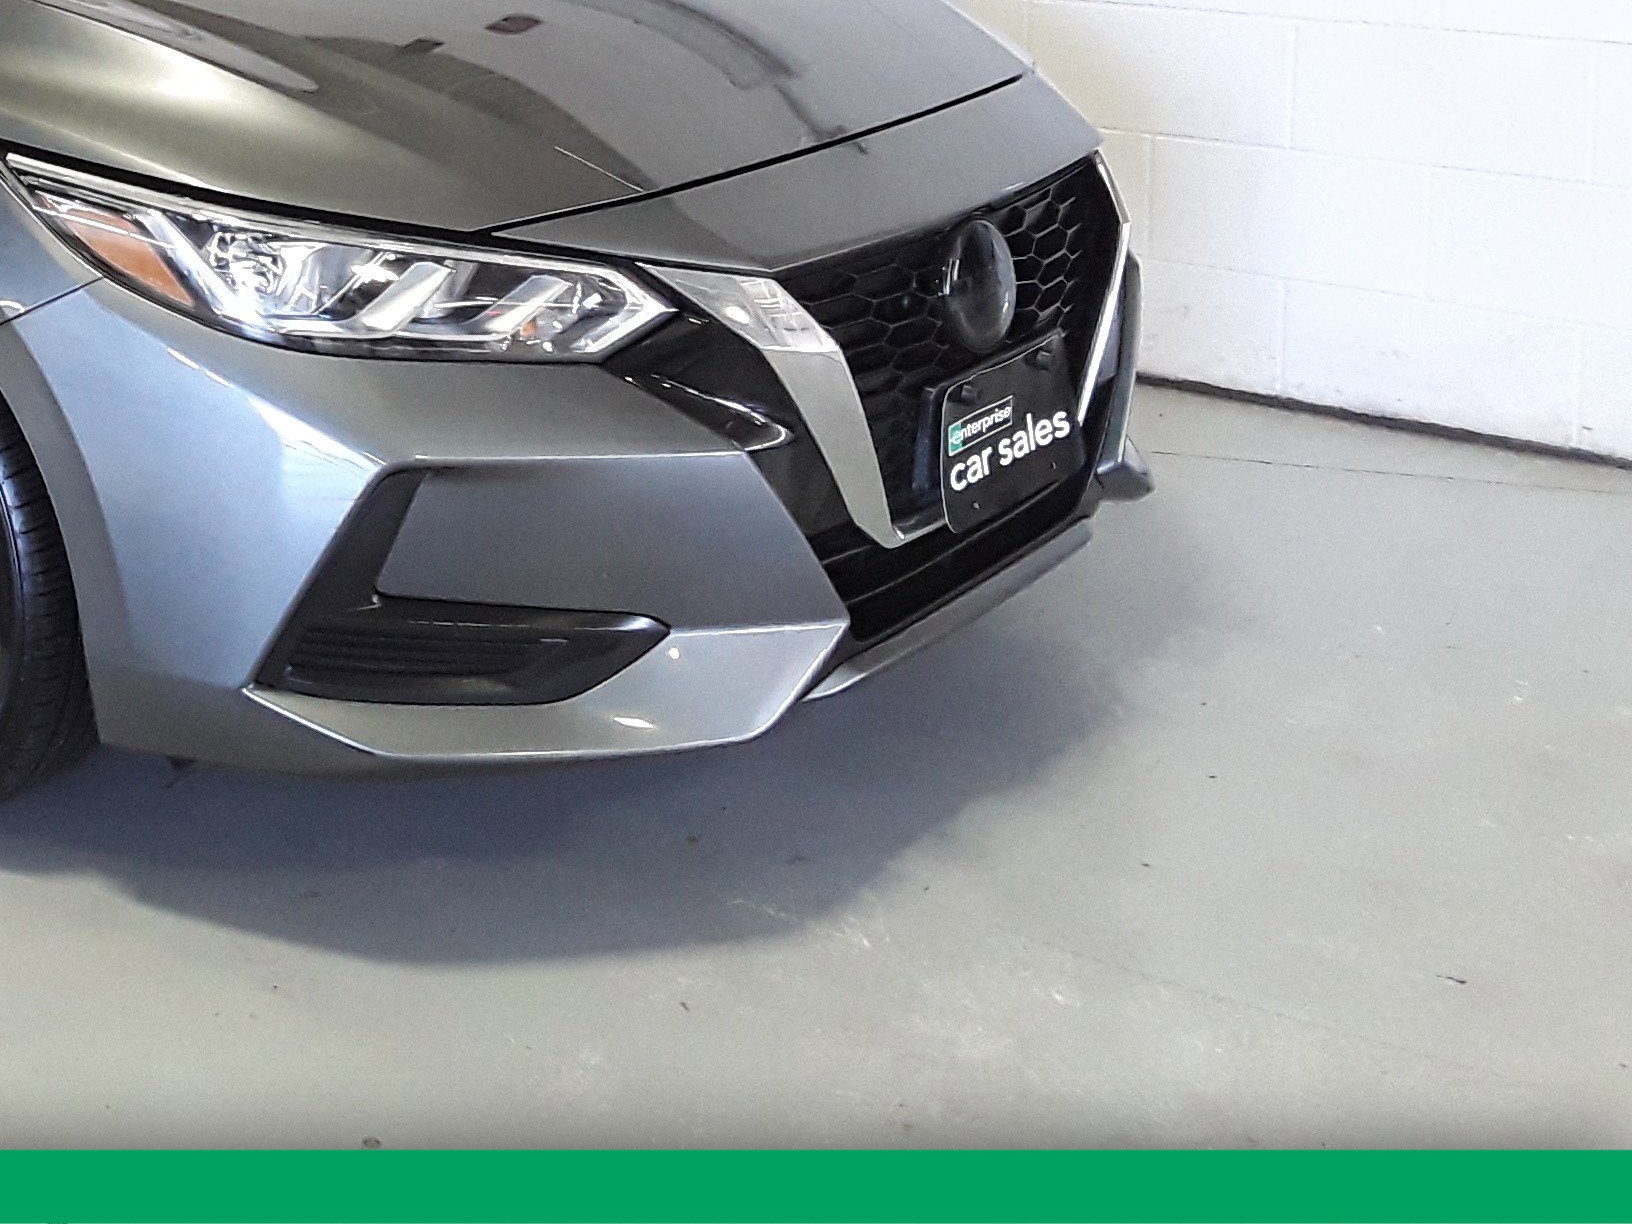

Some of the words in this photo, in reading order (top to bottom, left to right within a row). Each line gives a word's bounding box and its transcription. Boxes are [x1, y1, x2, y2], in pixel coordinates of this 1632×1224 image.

[950, 406, 1013, 445] enterprise
[950, 446, 993, 491] car
[998, 411, 1071, 466] sales
